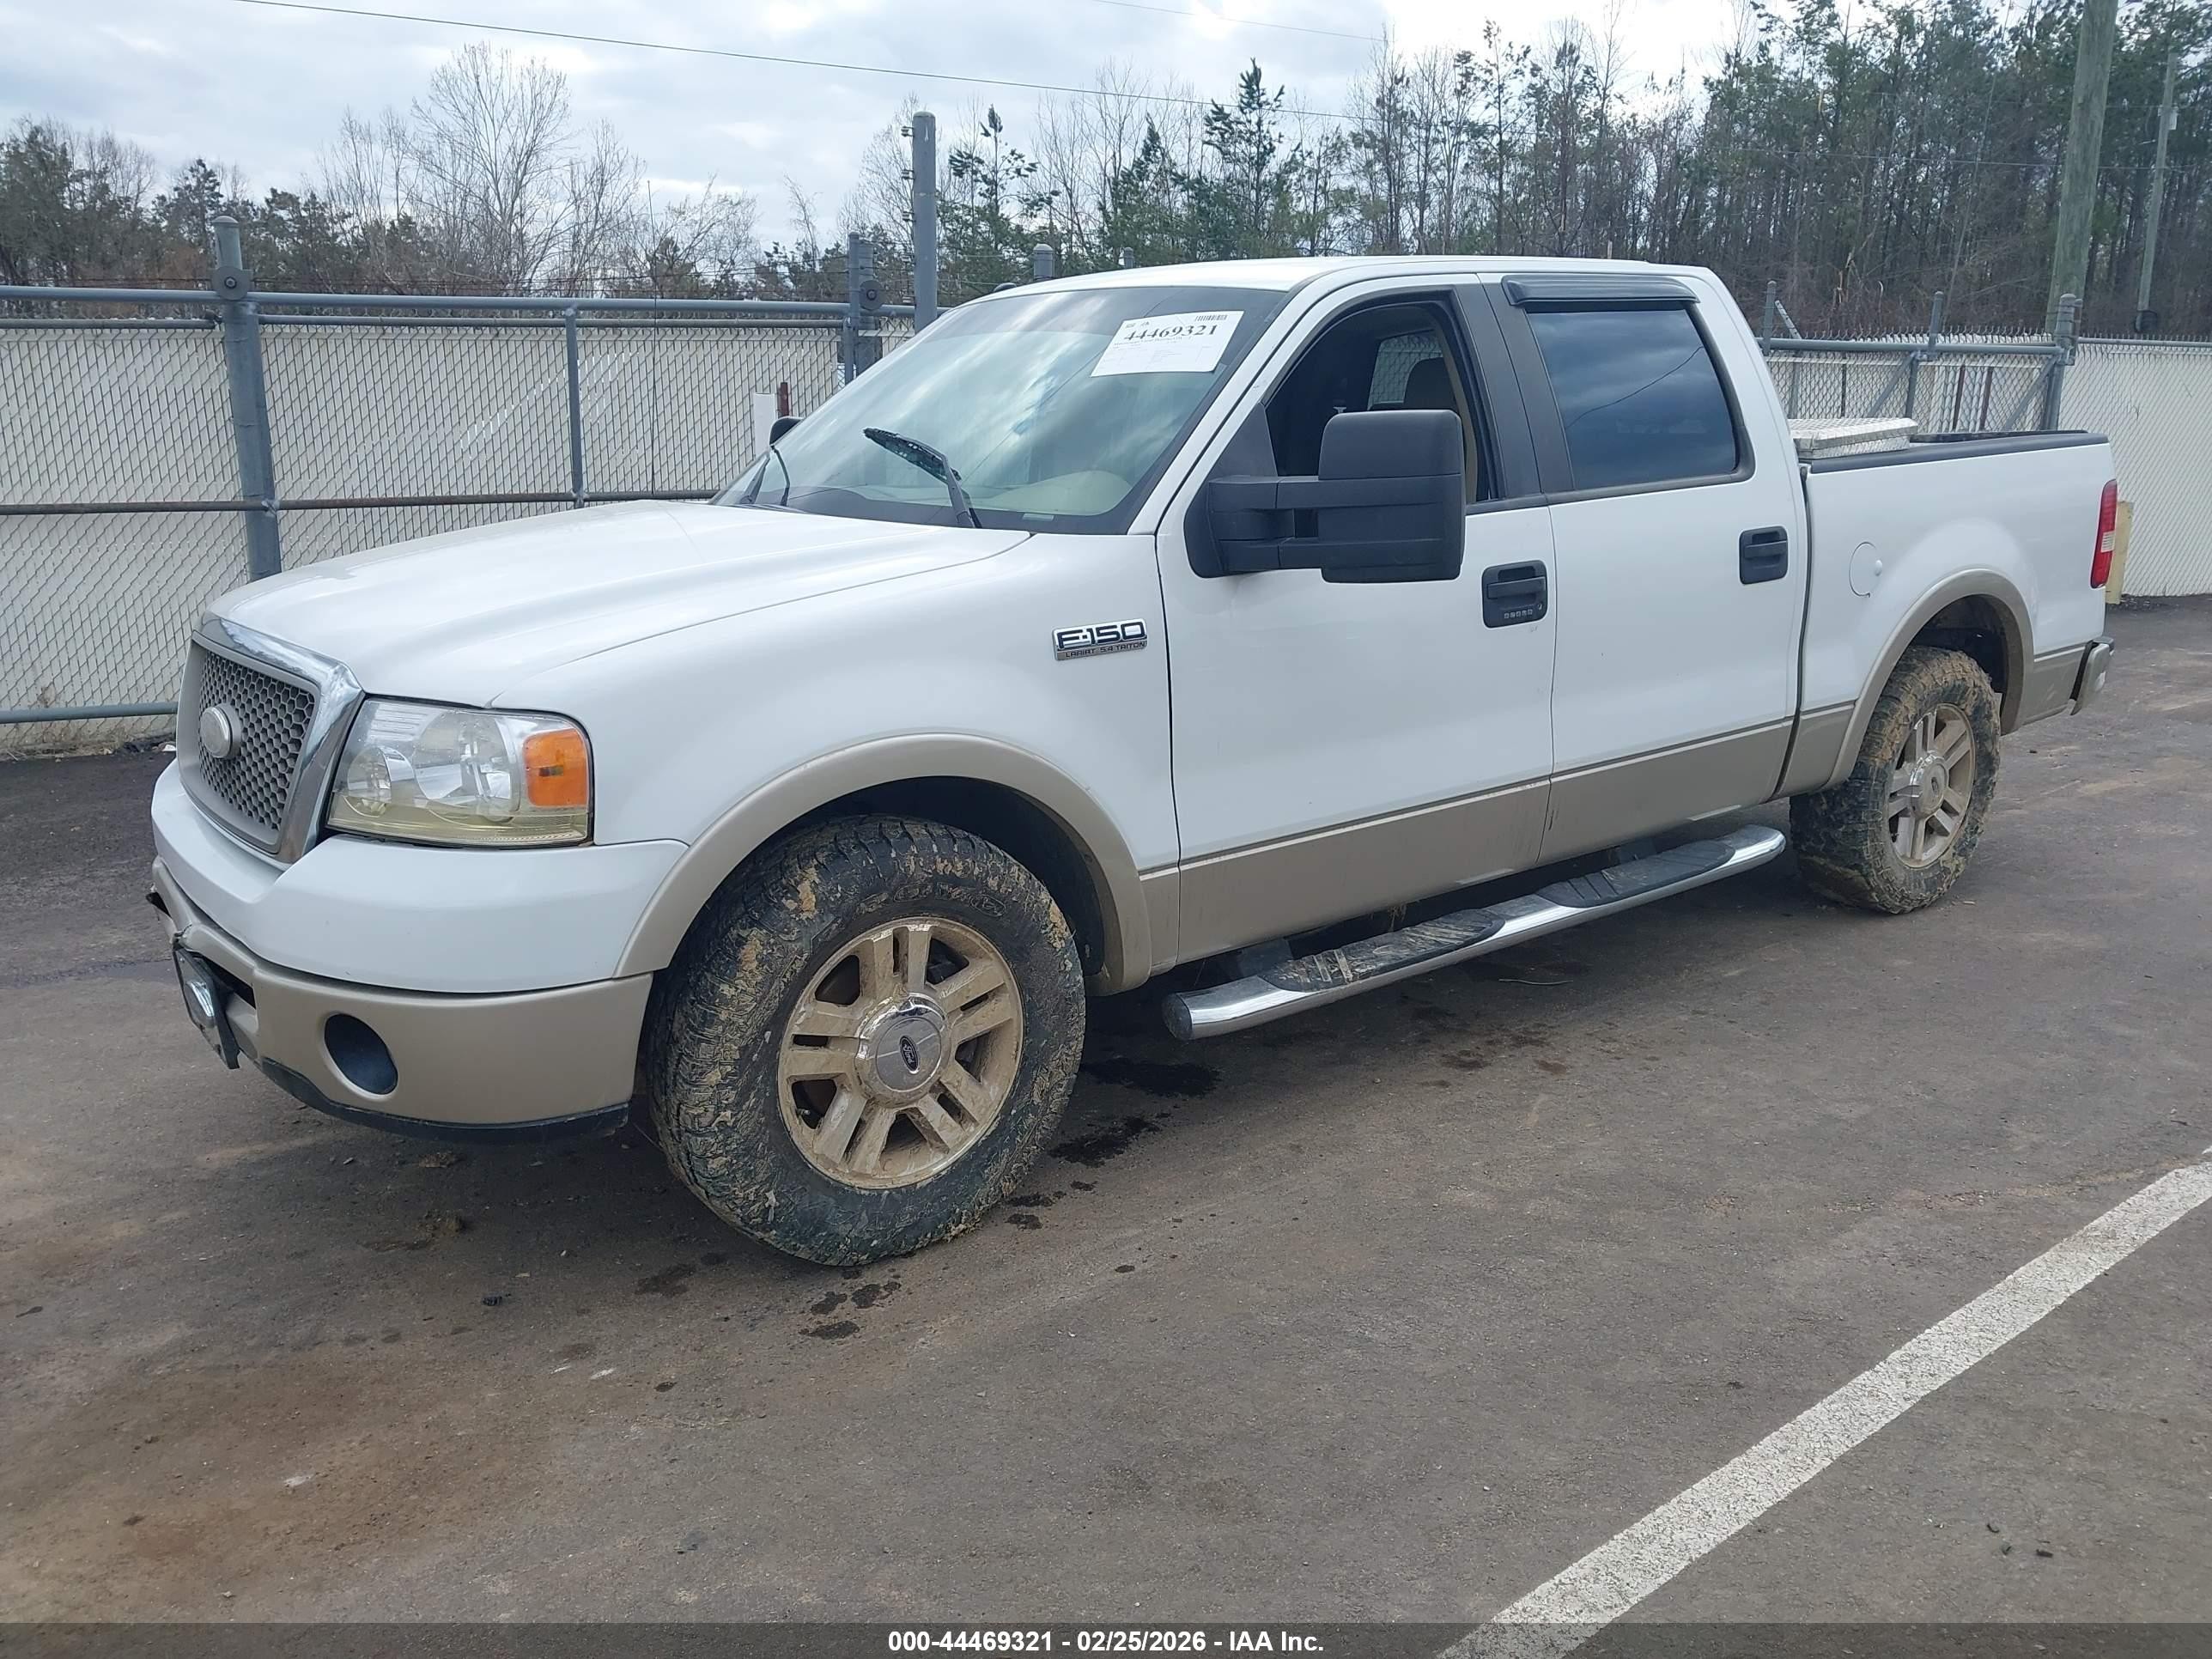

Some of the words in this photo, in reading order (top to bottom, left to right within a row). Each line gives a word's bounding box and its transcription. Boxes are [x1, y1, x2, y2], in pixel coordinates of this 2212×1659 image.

[1123, 325, 1218, 341] 44469321
[1056, 621, 1146, 649] F-150
[1065, 649, 1096, 658] LARIAT
[1115, 641, 1146, 652] TRITON
